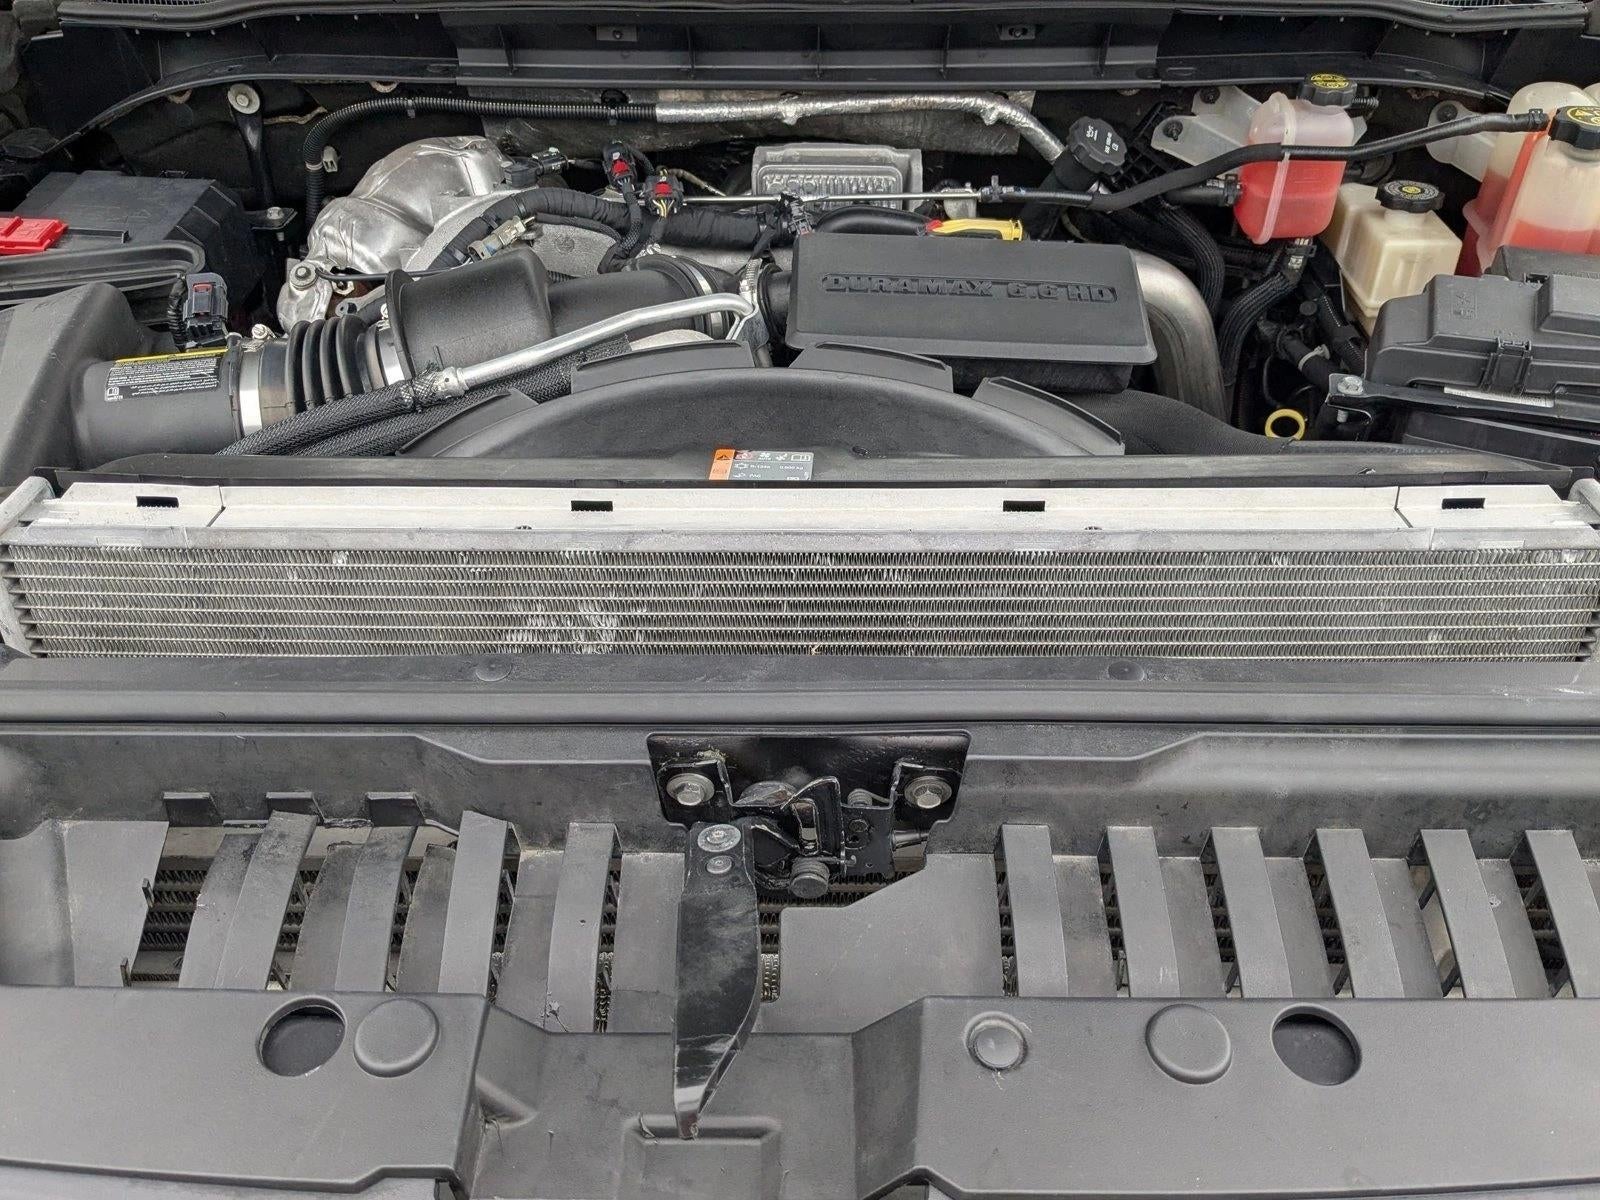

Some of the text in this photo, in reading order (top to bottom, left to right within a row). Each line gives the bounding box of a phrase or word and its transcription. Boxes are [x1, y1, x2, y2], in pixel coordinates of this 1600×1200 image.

[823, 275, 1118, 303] DURAMAX 6.6 HD
